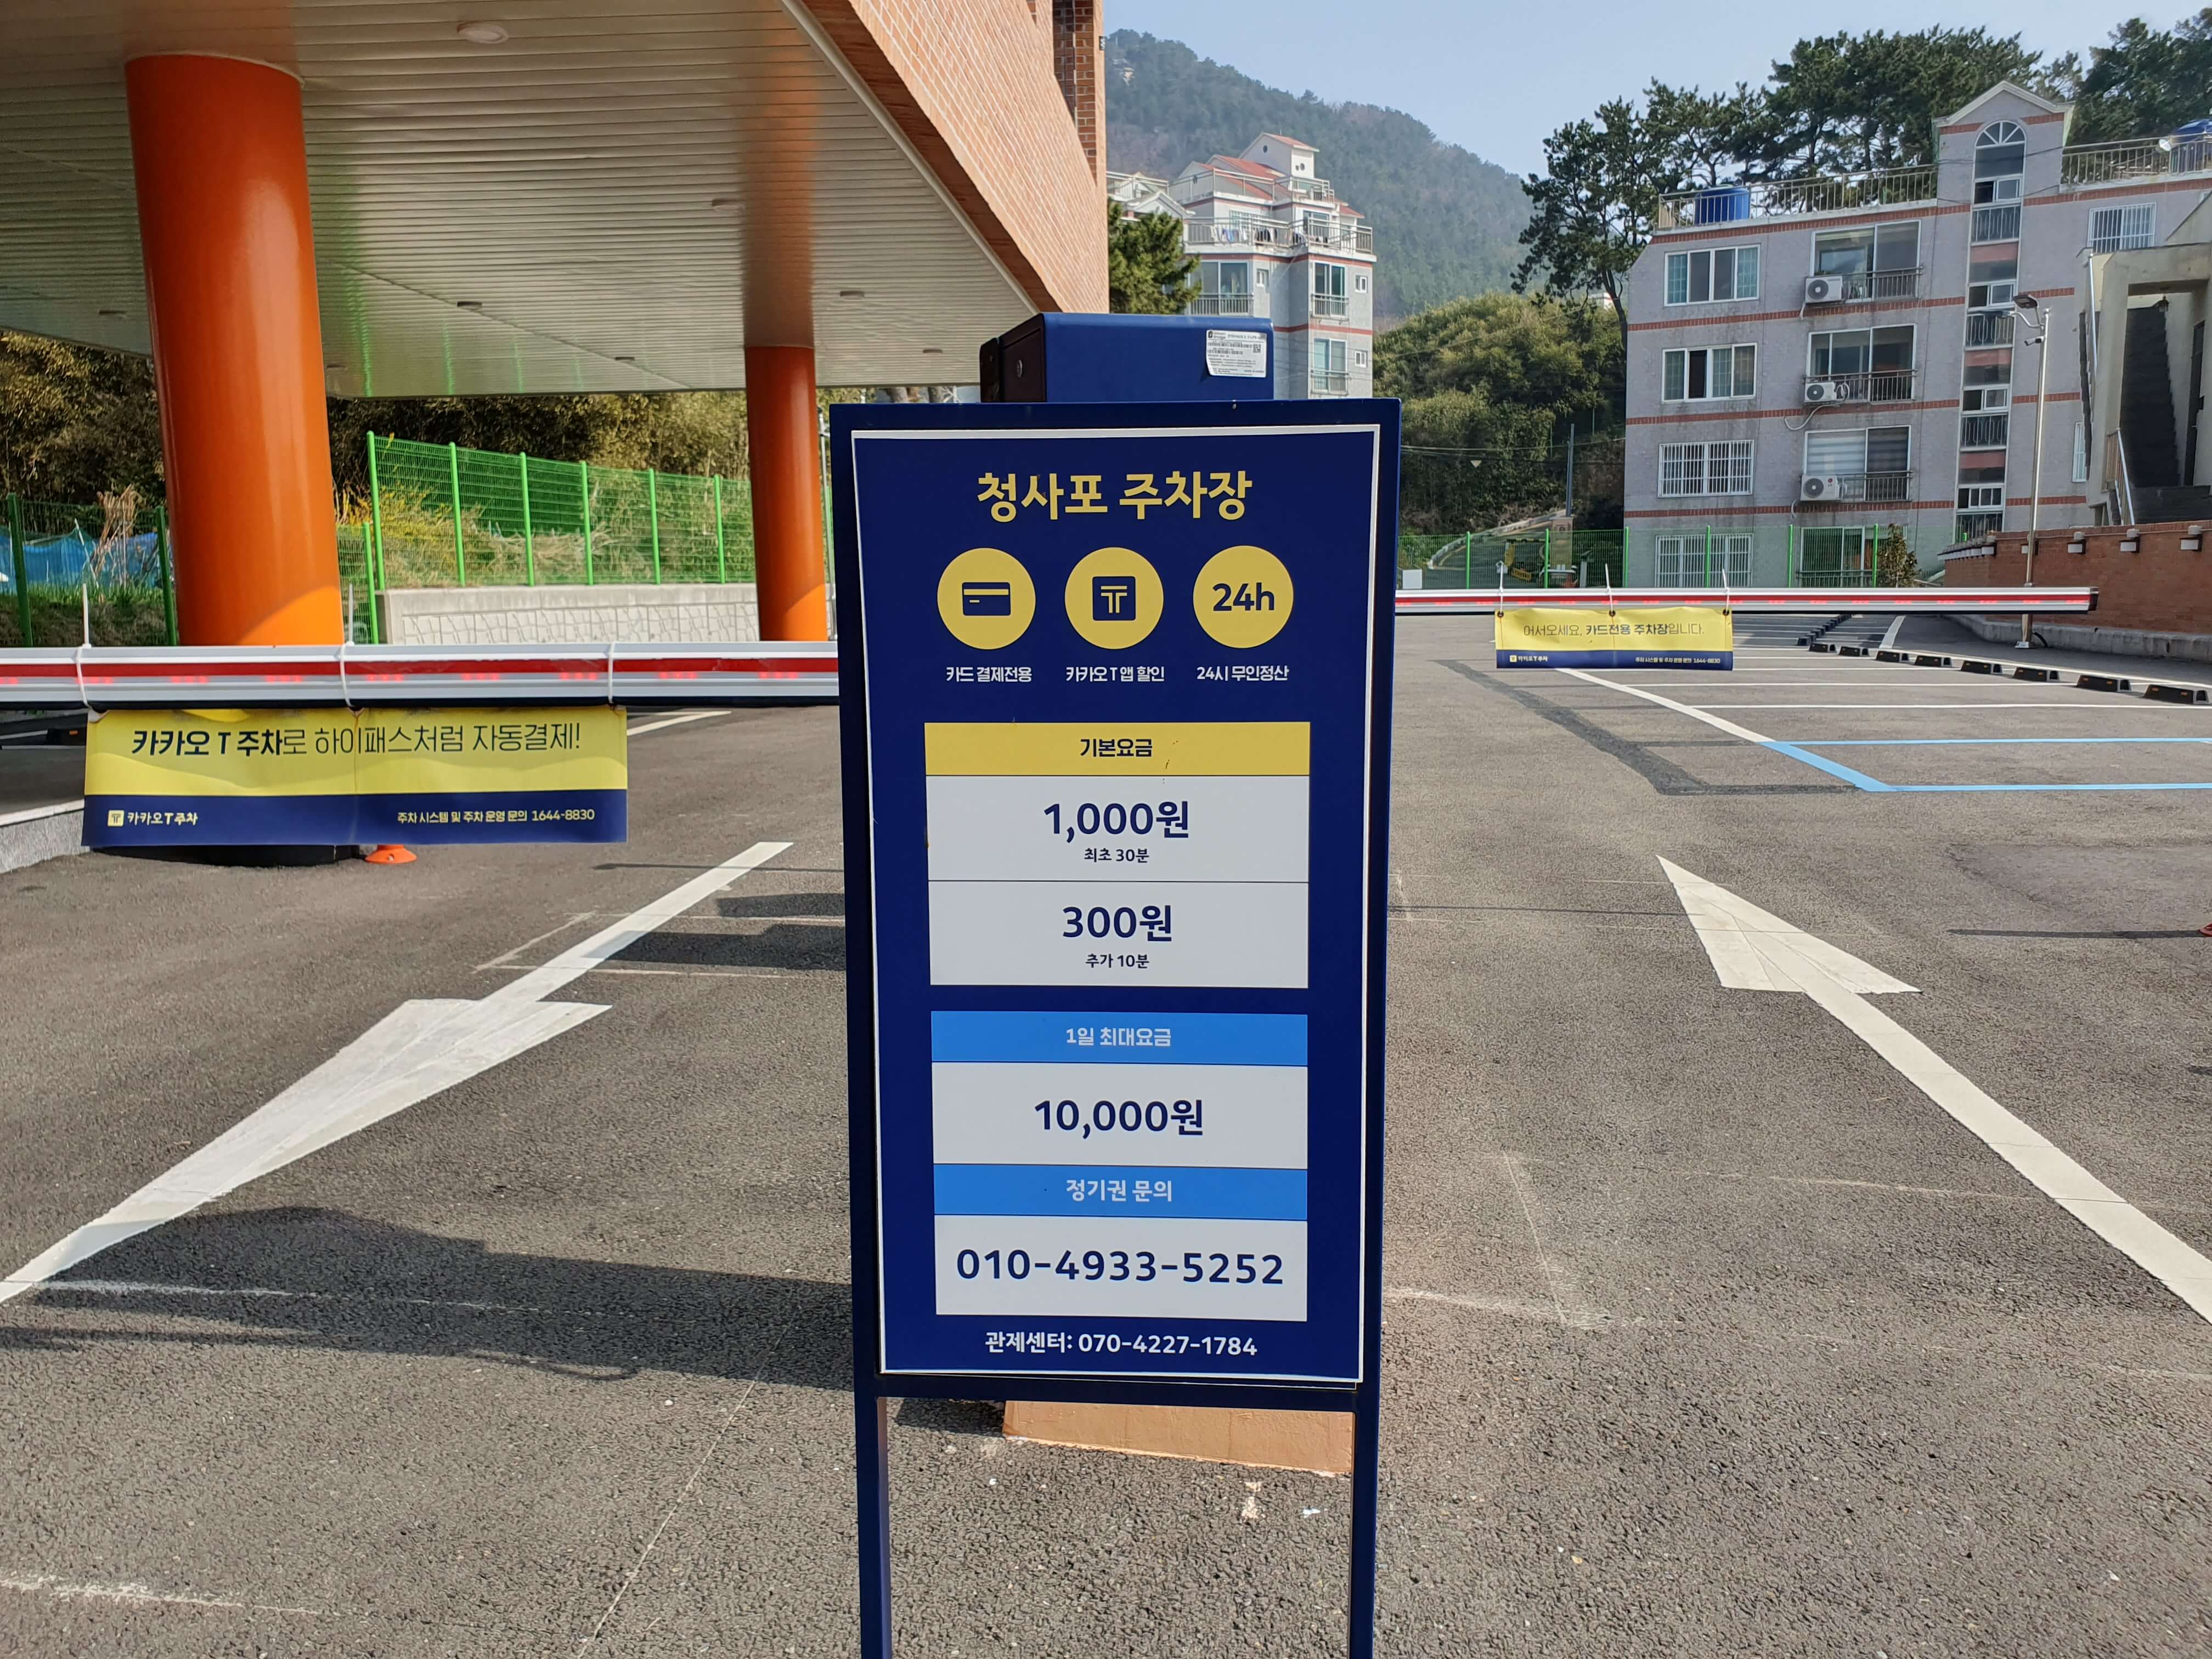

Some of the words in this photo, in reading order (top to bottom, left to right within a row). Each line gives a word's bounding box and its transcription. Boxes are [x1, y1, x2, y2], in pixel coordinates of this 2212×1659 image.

[977, 472, 1108, 523] 청사포
[1119, 470, 1252, 520] 주차장
[1212, 582, 1274, 612] 24h
[1523, 624, 1583, 636] 어서오세요,
[1585, 624, 1630, 635] 카드전용
[1633, 623, 1705, 635] 주차장입니다.
[946, 667, 974, 682] 카드
[977, 667, 1032, 682] 결제전용
[1066, 667, 1108, 682] 카카오
[1109, 667, 1118, 681] T
[1120, 666, 1134, 682] 앱
[1136, 665, 1165, 682] 할인
[1197, 665, 1229, 681] 24시
[1231, 665, 1290, 681] 무인정산
[132, 730, 210, 756] 카카오
[218, 731, 232, 754] T
[236, 728, 307, 757] 주차로
[314, 725, 464, 755] 하이패스처럼
[472, 723, 580, 751] 자동결제!
[1080, 738, 1153, 758] 기본요금
[397, 811, 417, 824] 주차
[463, 811, 484, 823] 주차
[485, 810, 505, 822] 운영
[507, 810, 528, 822] 문의
[532, 809, 595, 821] 1644-8830
[1043, 800, 1189, 843] 1,000원
[1084, 848, 1112, 863] 최초
[1116, 848, 1150, 864] 30분
[1063, 905, 1172, 942] 300원
[1085, 953, 1114, 969] 추가
[1117, 954, 1150, 969] 10분
[1066, 1028, 1094, 1046] 1일
[1099, 1027, 1172, 1047] 최대요금
[1035, 1099, 1203, 1140] 10,000원
[1066, 1179, 1127, 1202] 정기권
[1132, 1180, 1172, 1203] 문의
[956, 1249, 1283, 1285] 010-4933-5252
[985, 1331, 1073, 1354] 관제센터:
[1078, 1333, 1258, 1356] 070-4227-1784
